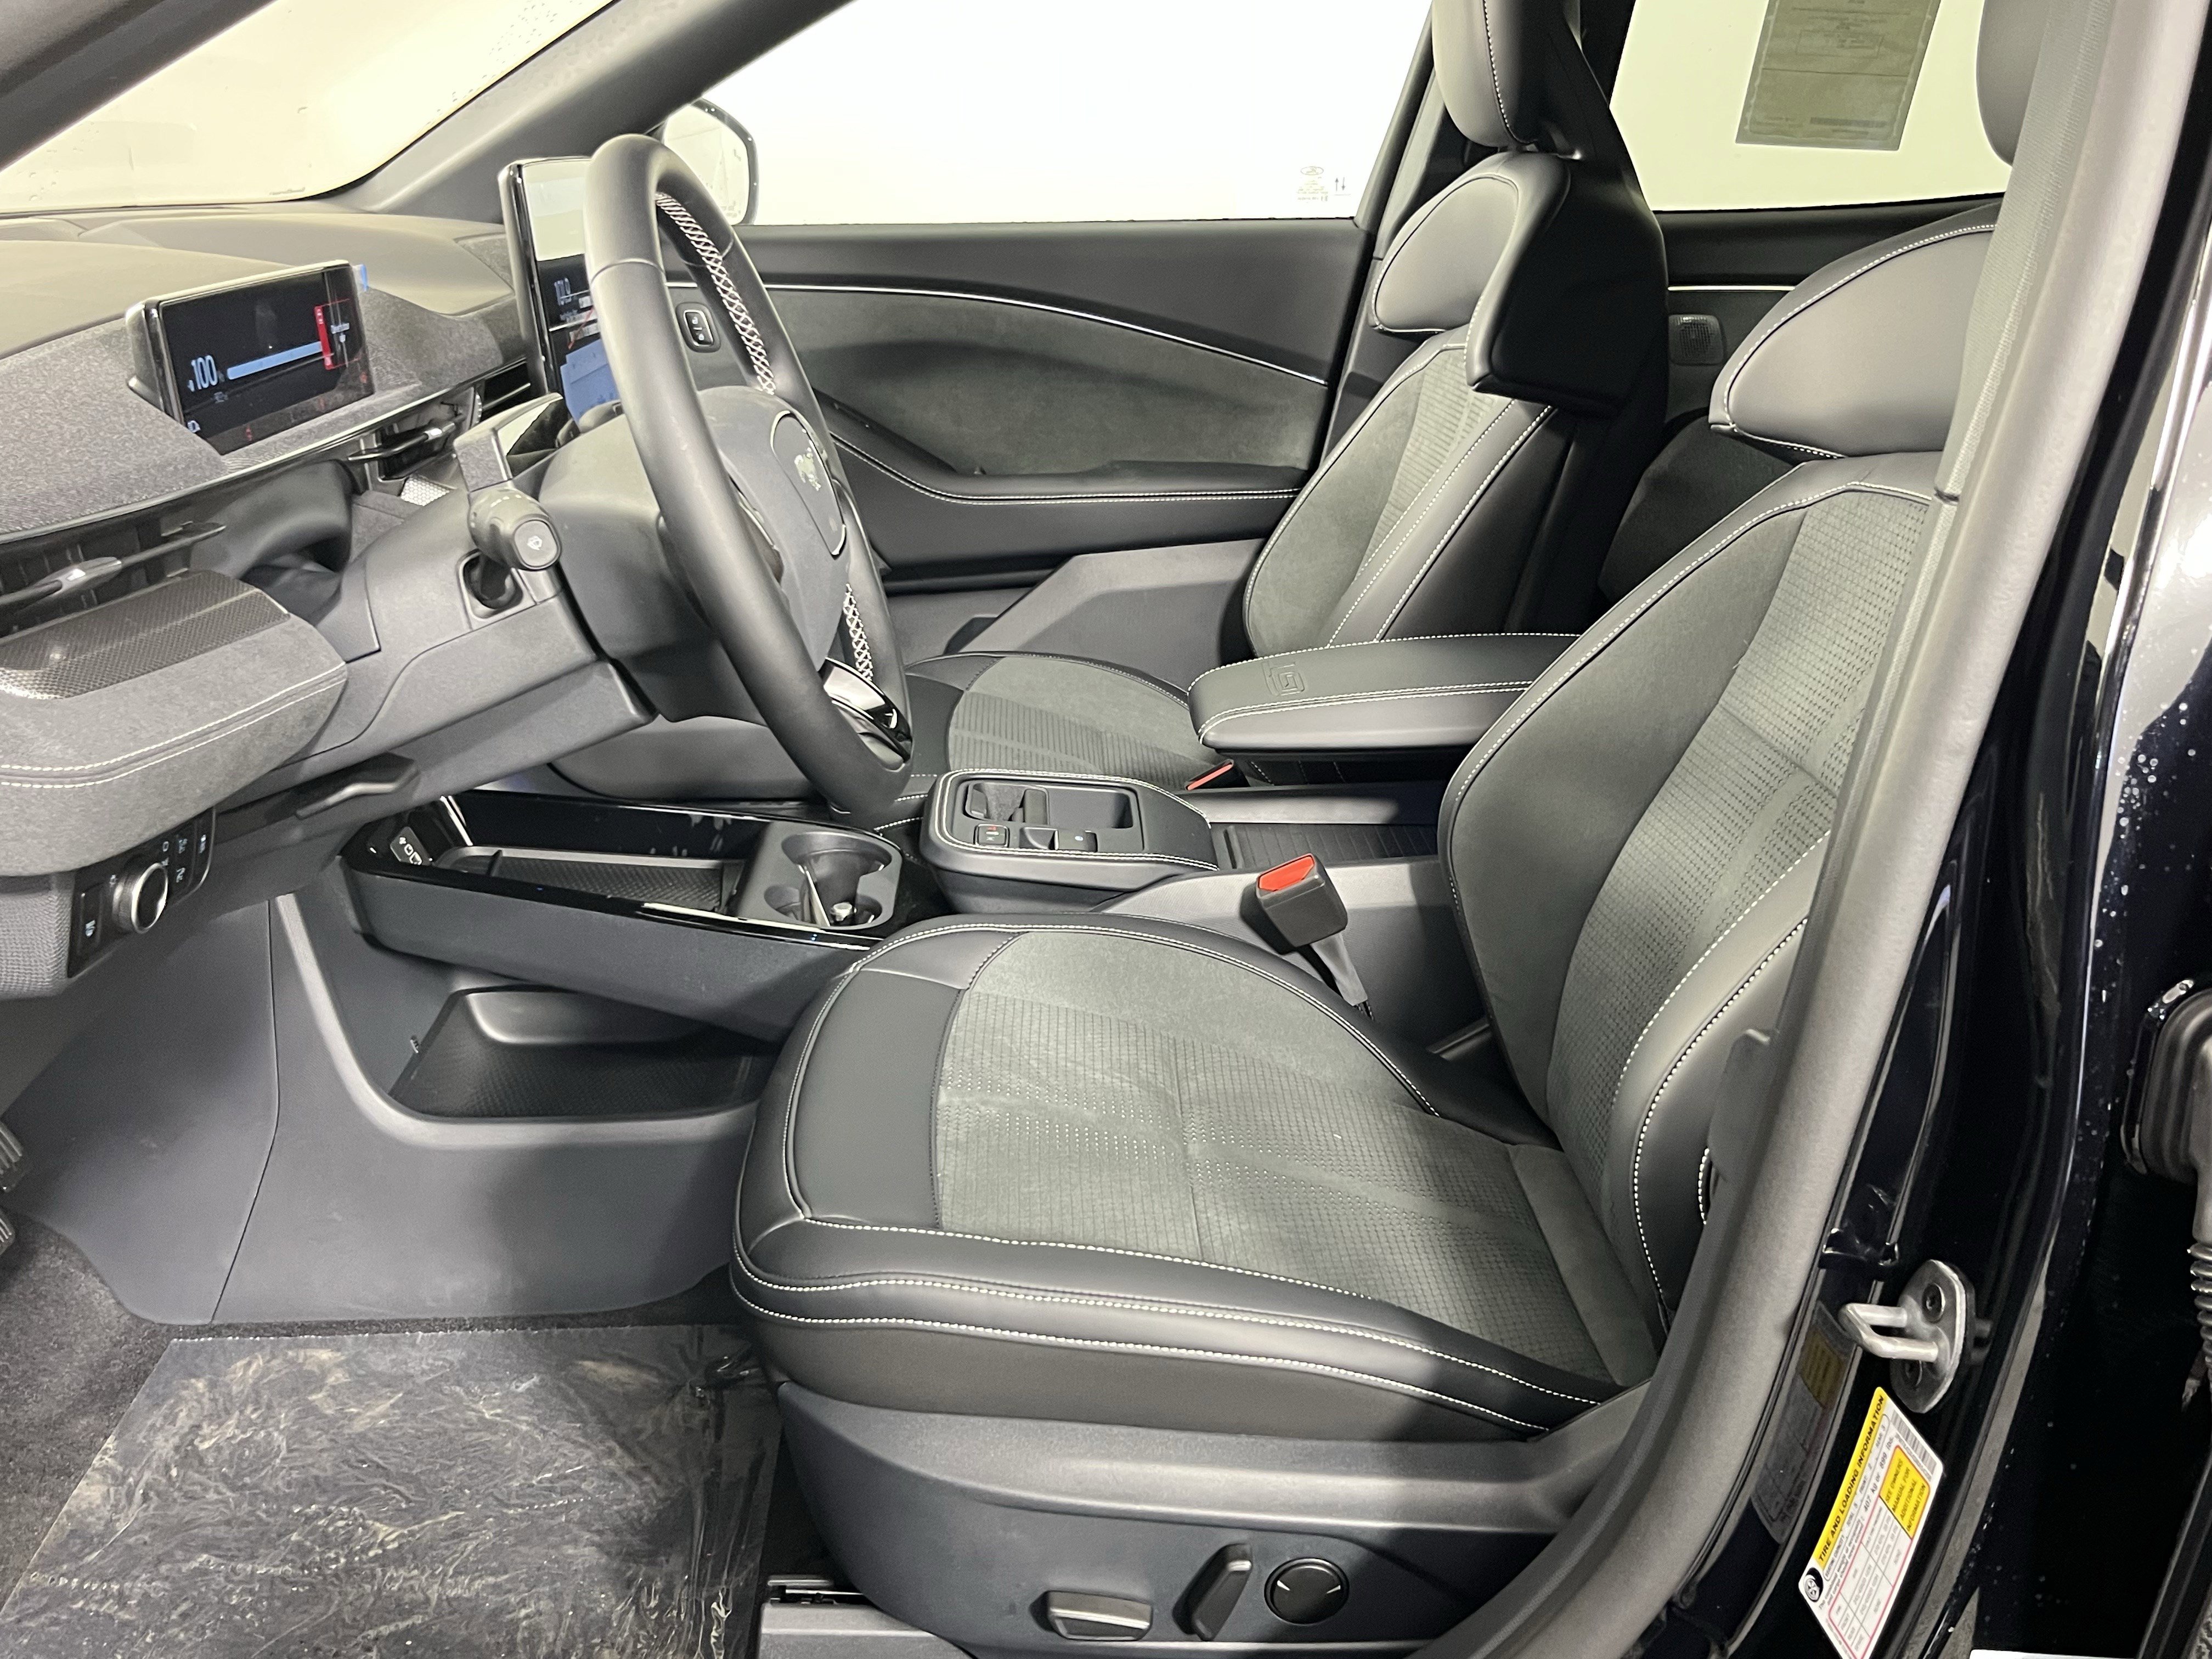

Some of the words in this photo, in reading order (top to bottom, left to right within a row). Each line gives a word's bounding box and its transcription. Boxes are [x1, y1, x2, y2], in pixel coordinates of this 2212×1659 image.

[1819, 1537, 1831, 1562] TIRE
[1830, 1514, 1841, 1537] AND
[1839, 1469, 1859, 1514] LOADING
[1857, 1395, 1884, 1467] INFORMATION
[1892, 1482, 1905, 1512] MANUAL
[1899, 1479, 1917, 1520] ADDITIONAL
[1906, 1483, 1926, 1531] INFORMATION
